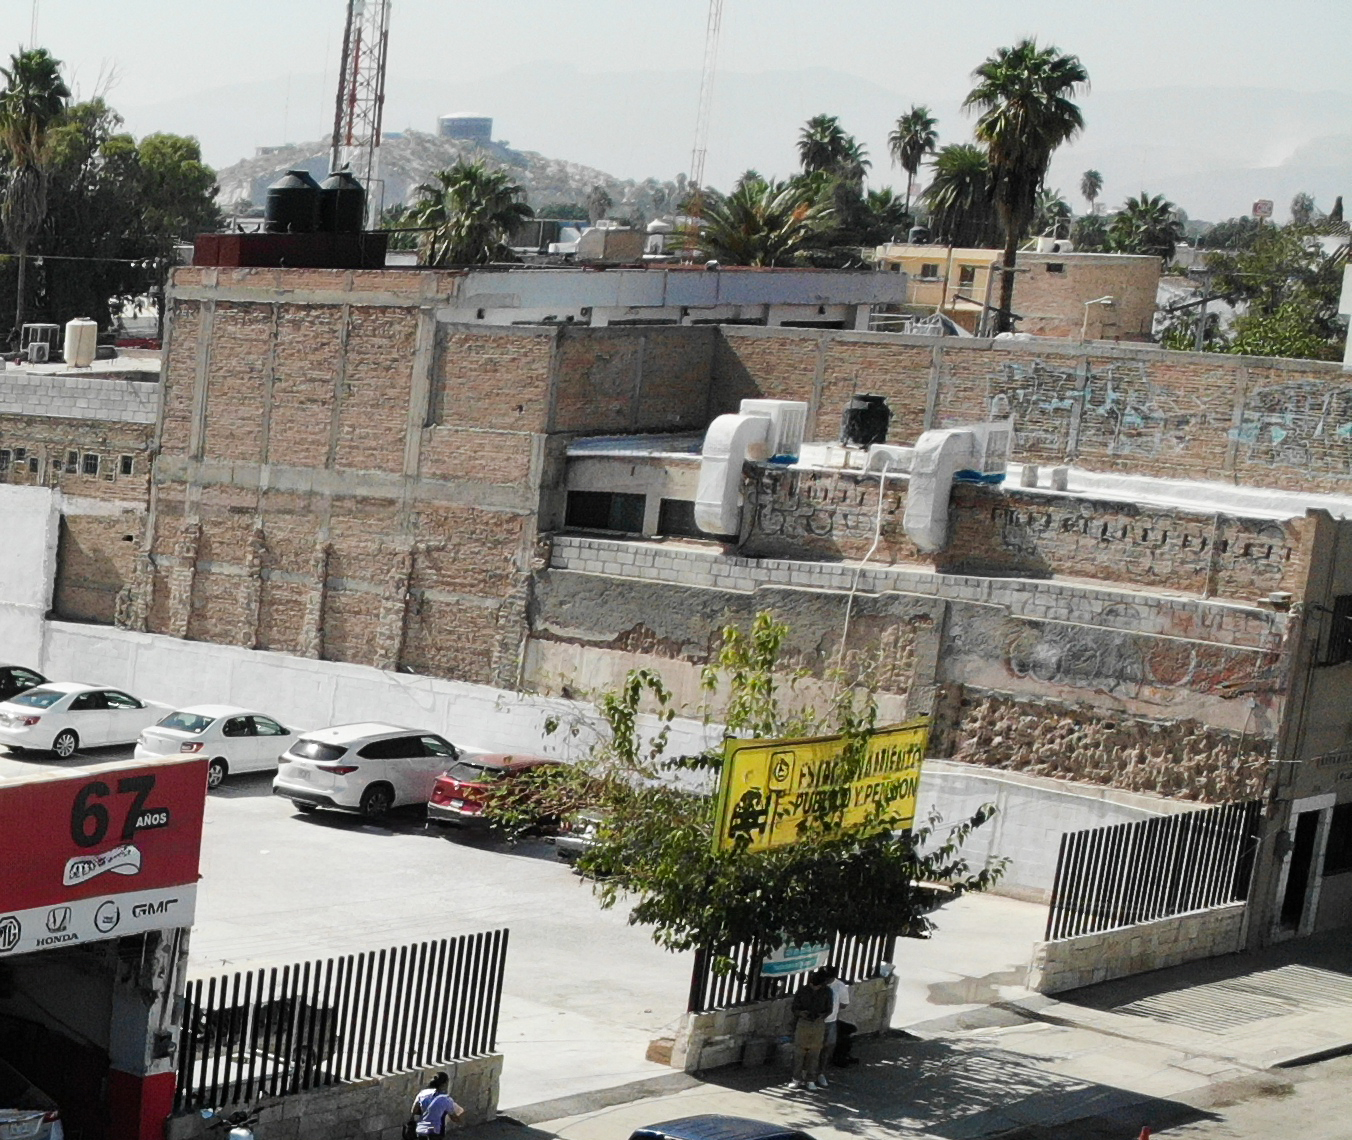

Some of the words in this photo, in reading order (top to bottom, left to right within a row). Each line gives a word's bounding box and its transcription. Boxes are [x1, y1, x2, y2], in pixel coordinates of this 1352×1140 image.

[71, 774, 156, 847] 67
[135, 812, 167, 827] AÑOS
[36, 932, 80, 947] HONDA
